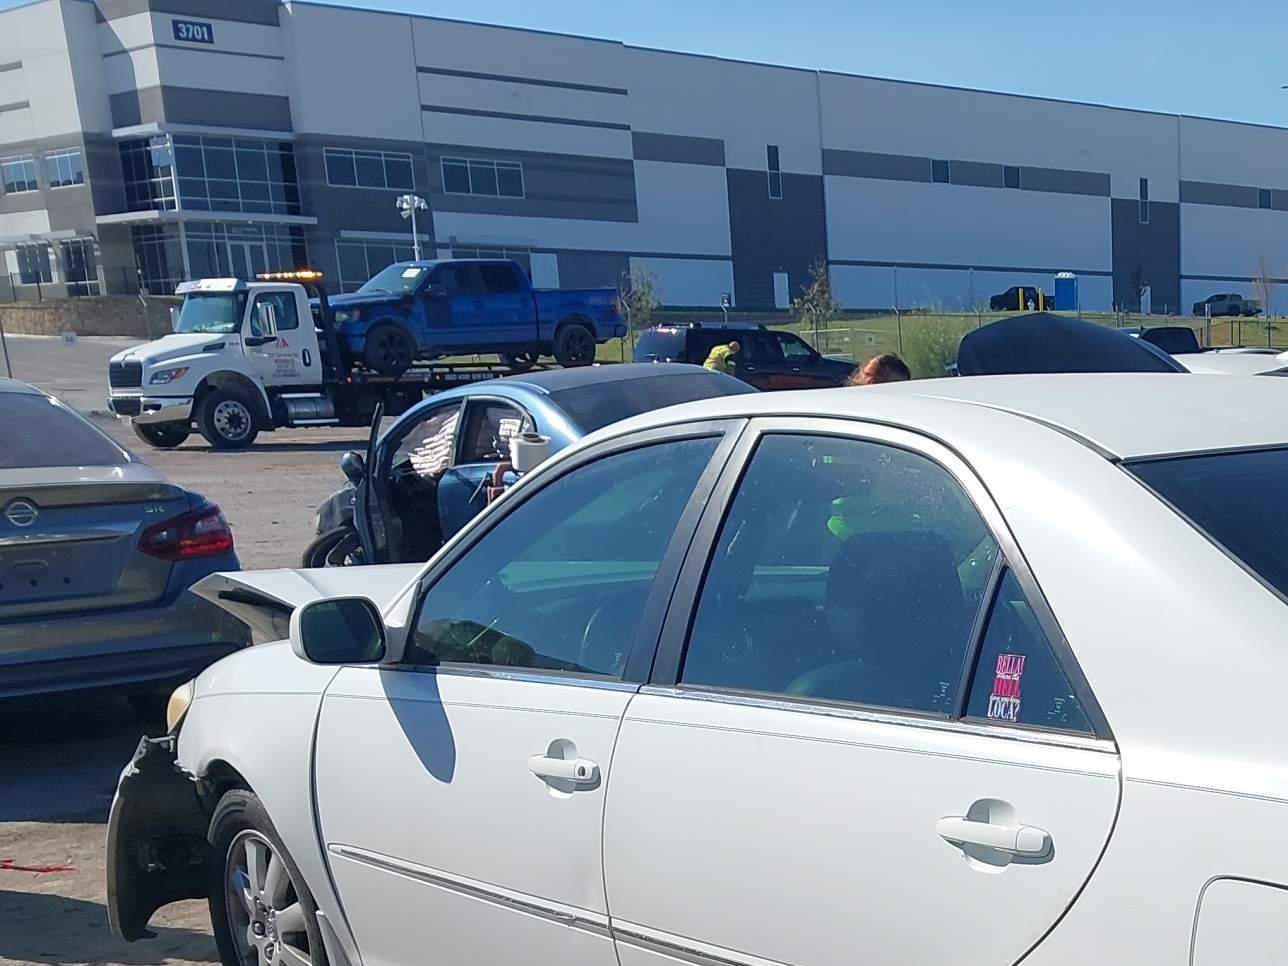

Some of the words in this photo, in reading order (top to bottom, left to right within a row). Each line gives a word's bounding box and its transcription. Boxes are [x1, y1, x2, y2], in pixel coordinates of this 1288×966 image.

[178, 23, 208, 40] 3701
[995, 655, 1025, 674] BELLA!
[987, 698, 1020, 721] LOCA?
